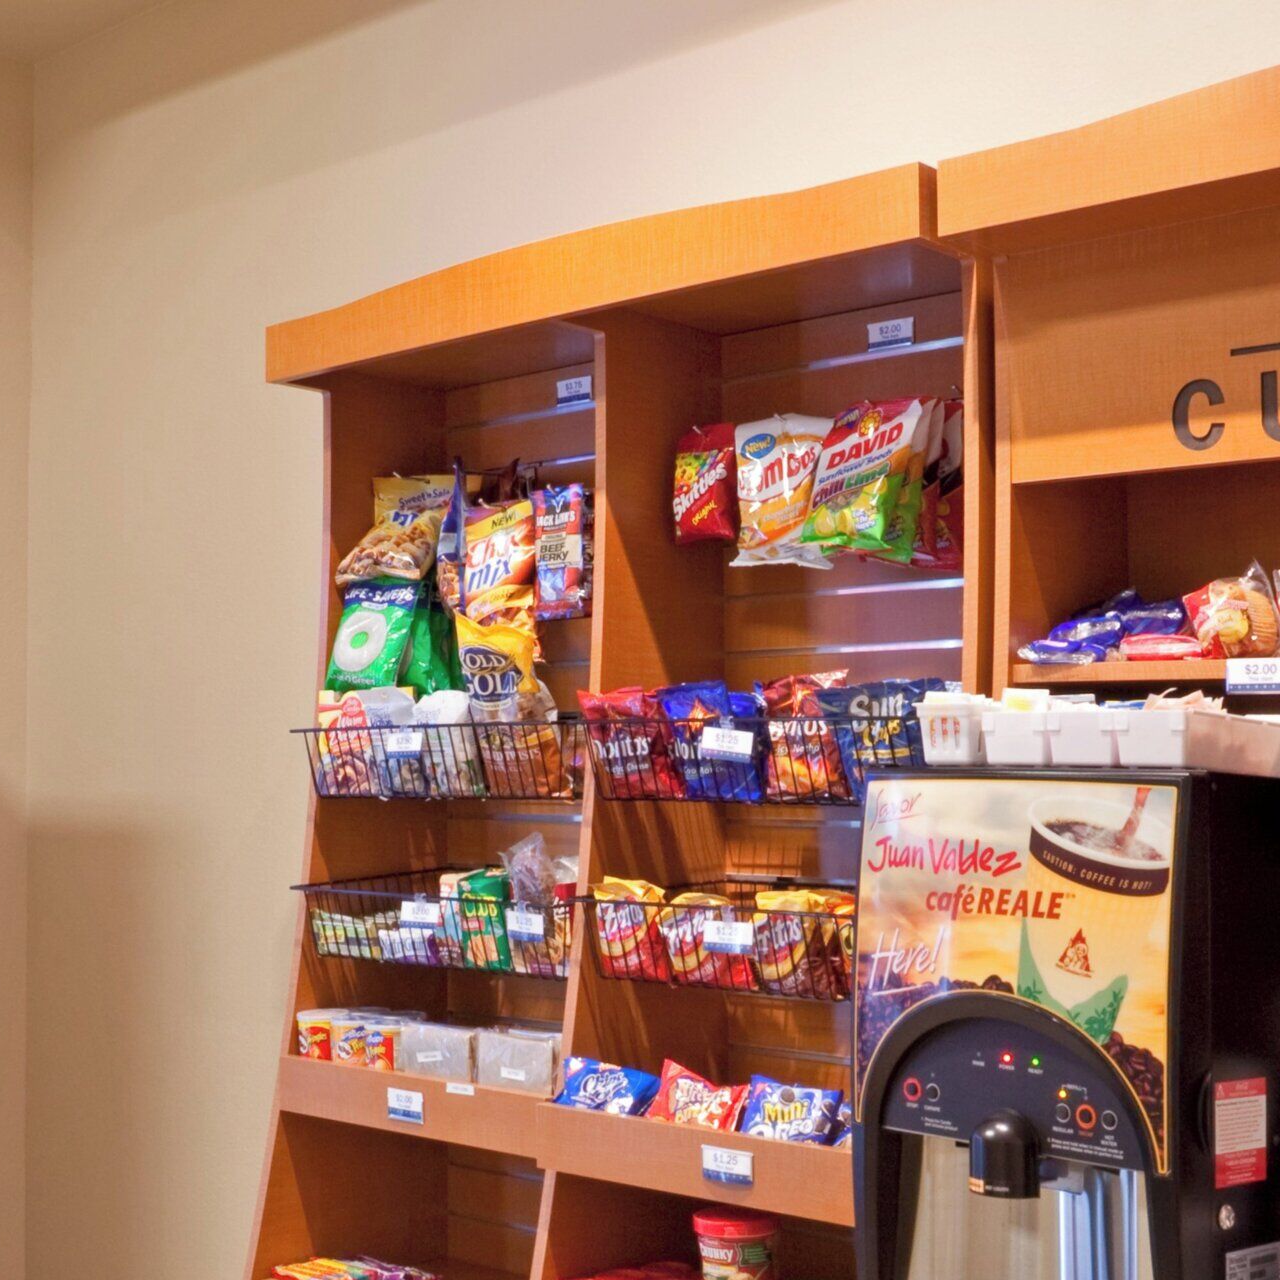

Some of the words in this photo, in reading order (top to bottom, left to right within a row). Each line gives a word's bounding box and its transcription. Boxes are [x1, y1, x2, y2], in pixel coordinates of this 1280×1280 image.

[878, 323, 902, 336] $2.00
[826, 422, 903, 471] DAVID
[673, 462, 728, 522] Skittles
[538, 551, 569, 563] JERKY
[540, 542, 566, 553] BEEF
[1243, 663, 1278, 676] $2.00
[867, 835, 924, 874] Juan
[928, 836, 1023, 878] Valdez
[1042, 850, 1078, 878] CAUTION:
[1080, 866, 1116, 888] COFFEE
[1119, 876, 1130, 888] IS
[1131, 878, 1153, 892] HOT!
[869, 926, 945, 991] Here!
[762, 1100, 809, 1123] Mini
[711, 1151, 739, 1167] $1.25
